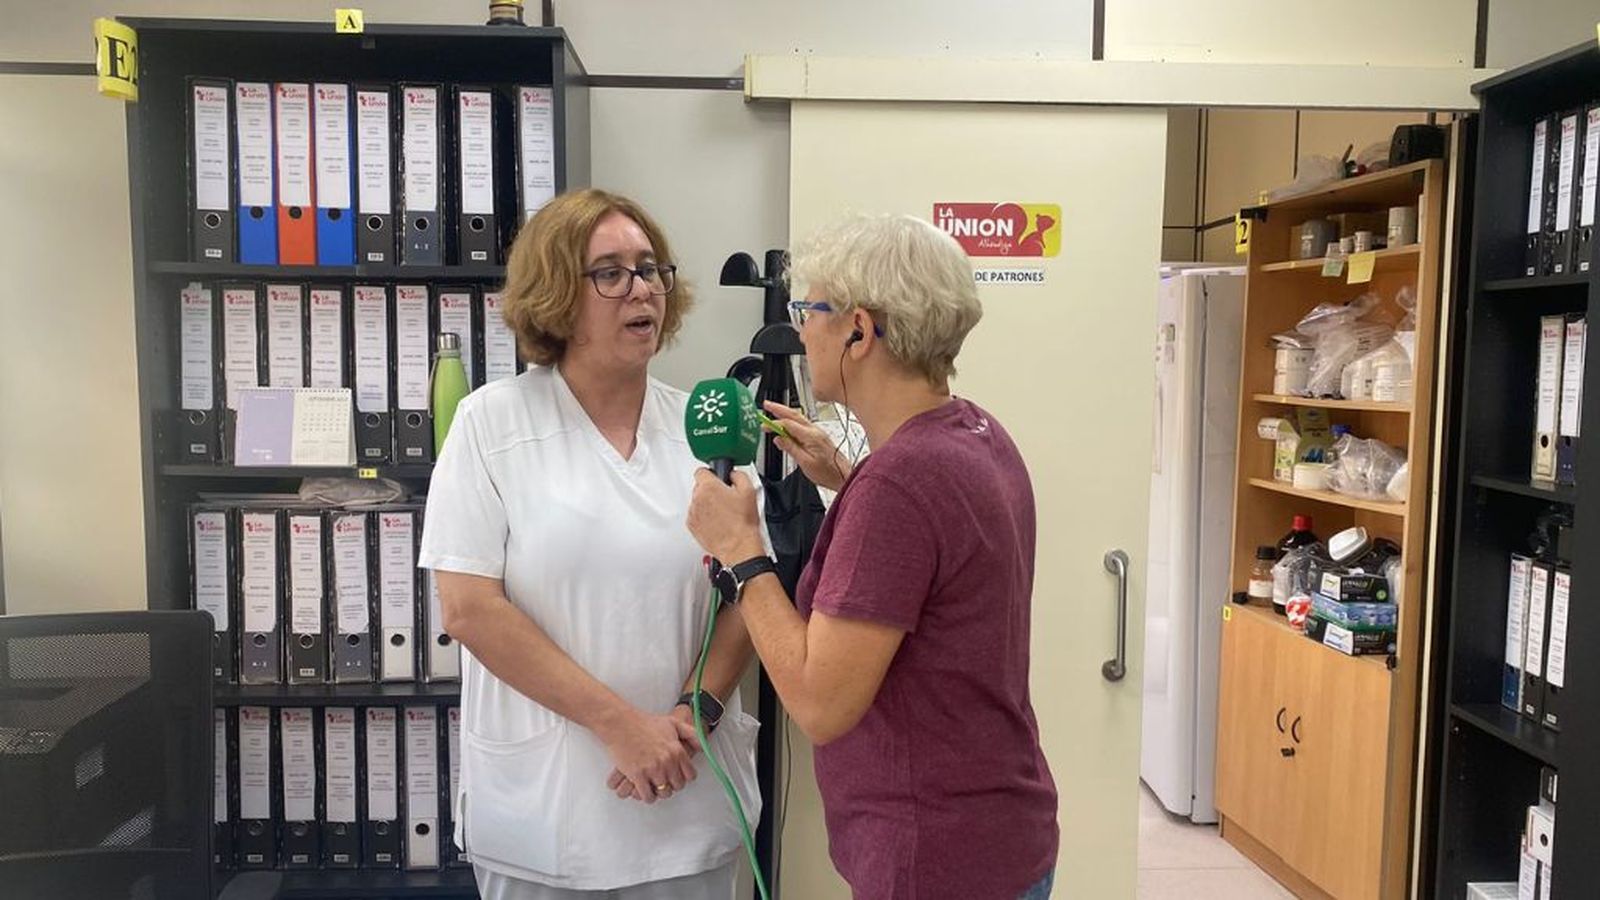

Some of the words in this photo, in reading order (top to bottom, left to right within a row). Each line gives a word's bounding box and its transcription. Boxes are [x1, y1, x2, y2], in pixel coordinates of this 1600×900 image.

[343, 15, 357, 29] A
[939, 207, 954, 217] LA
[939, 219, 1013, 236] UNION
[975, 272, 988, 282] DE
[990, 272, 1044, 282] PATRONES
